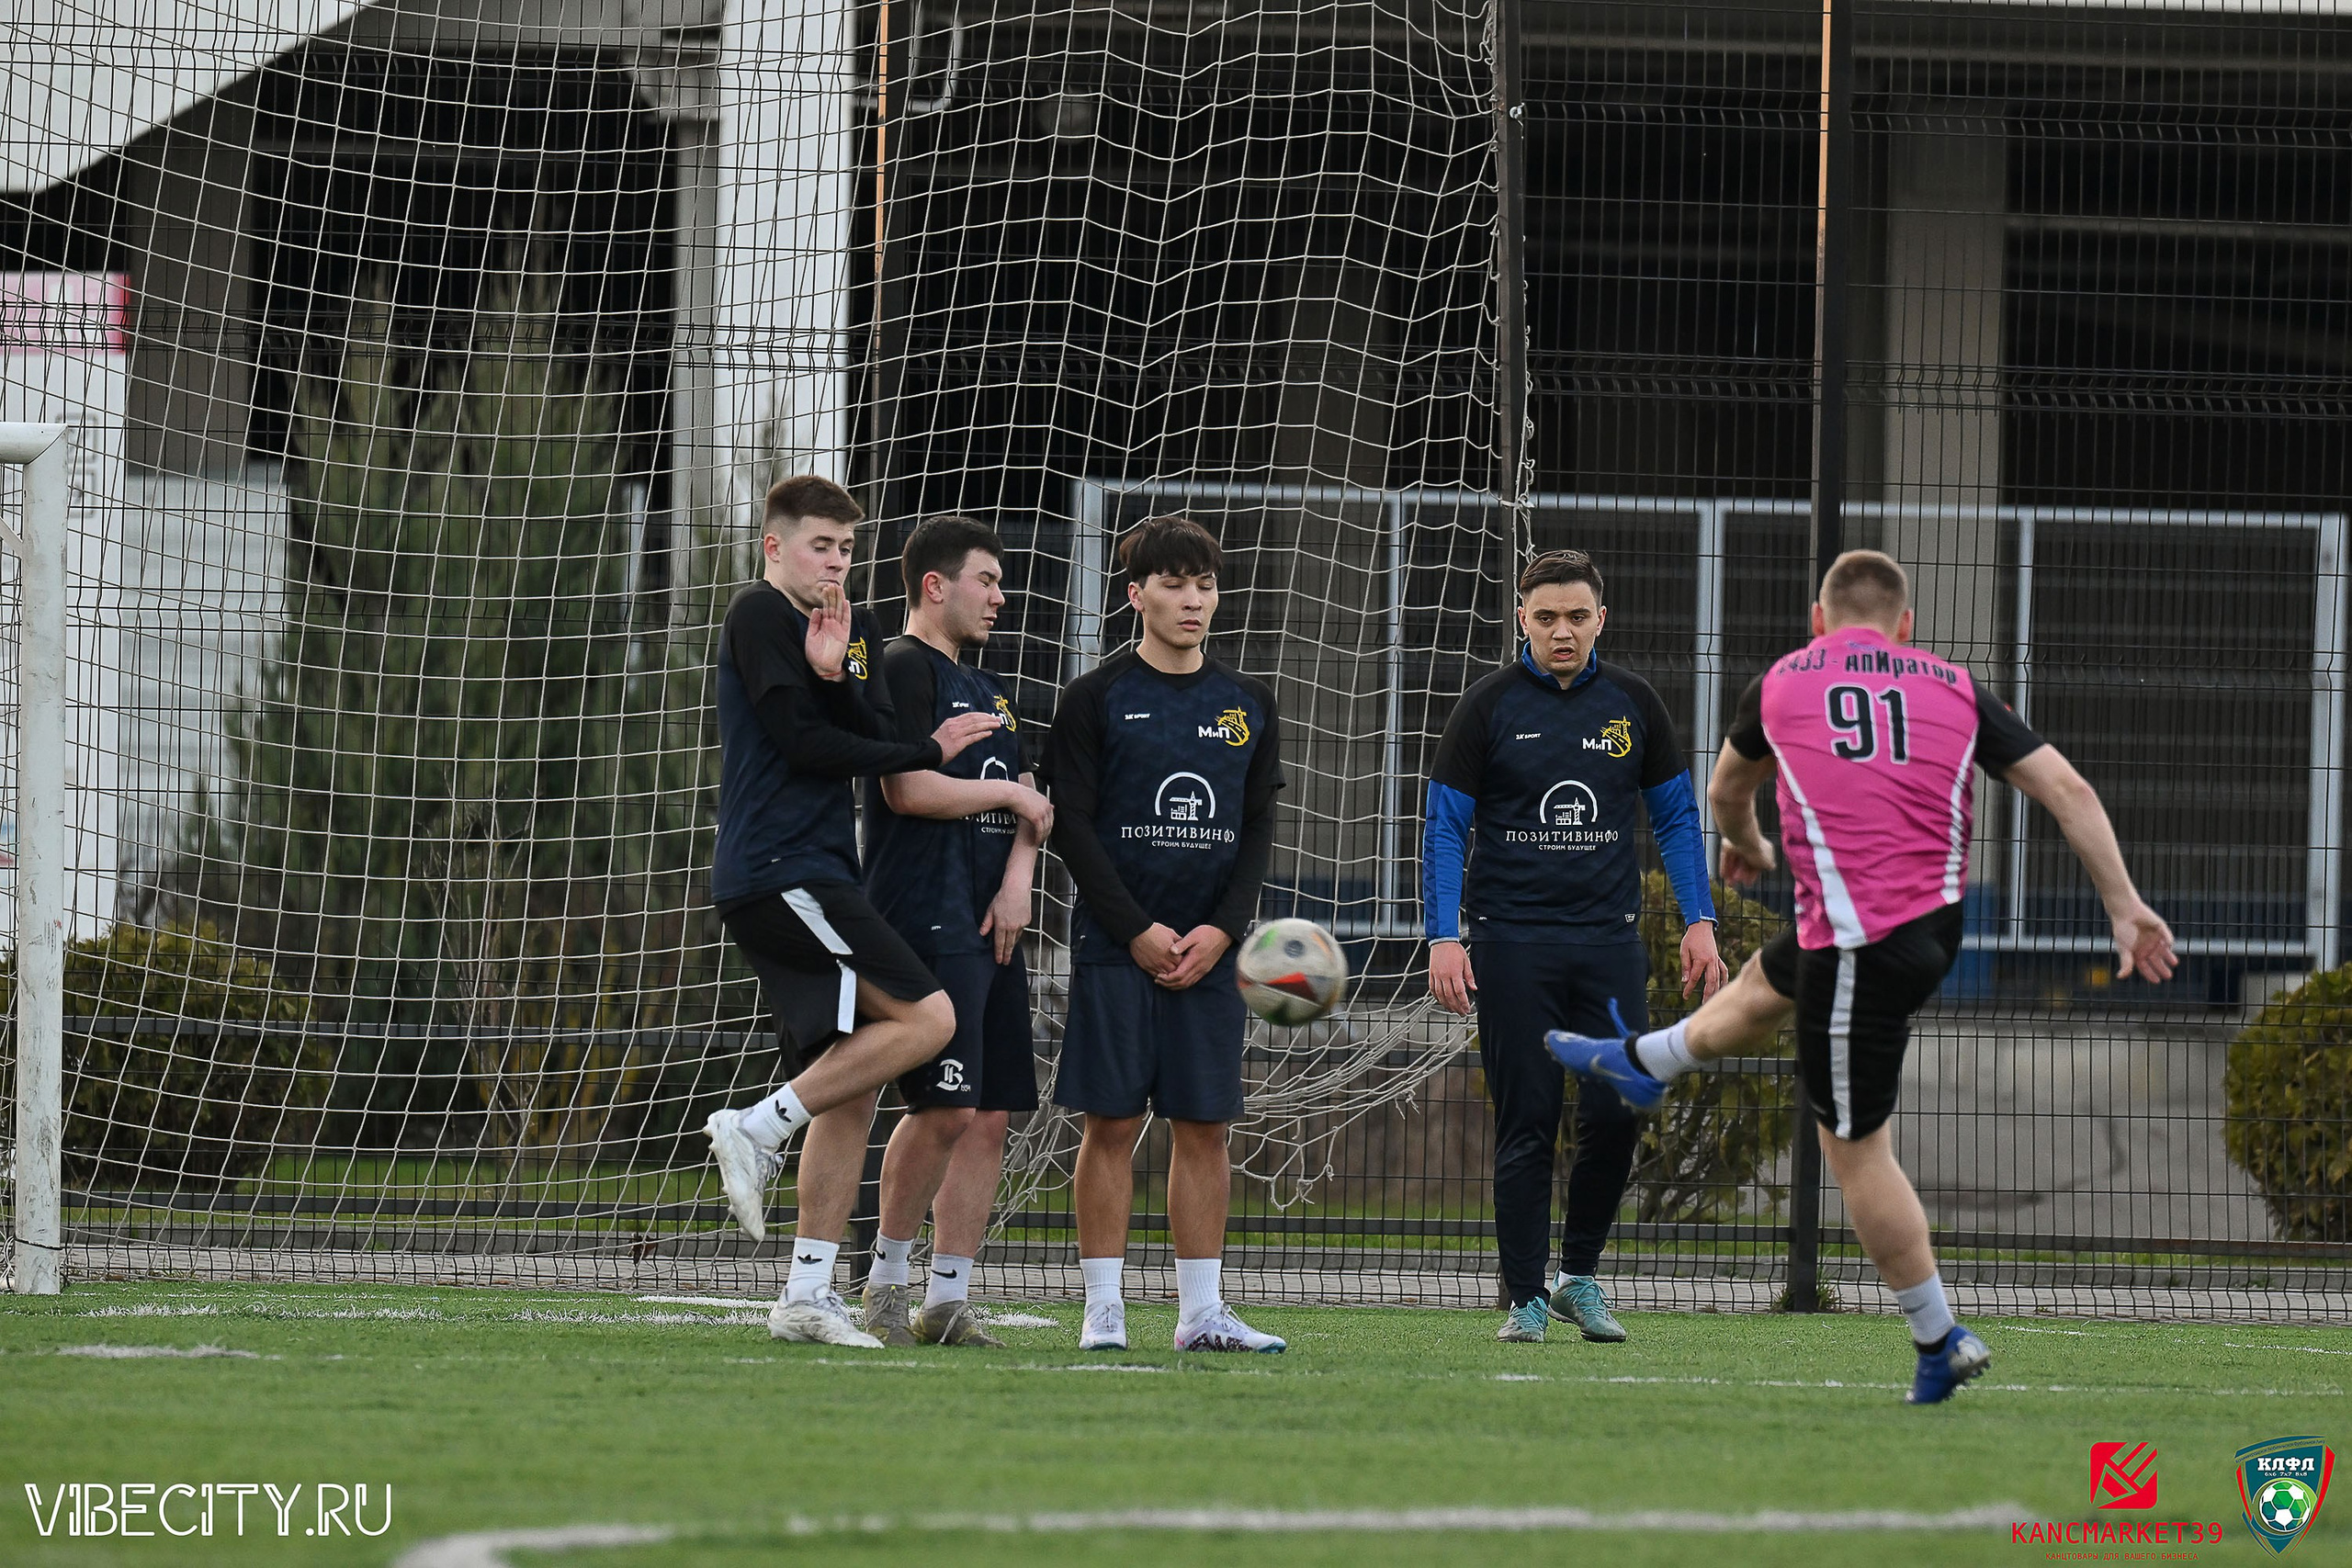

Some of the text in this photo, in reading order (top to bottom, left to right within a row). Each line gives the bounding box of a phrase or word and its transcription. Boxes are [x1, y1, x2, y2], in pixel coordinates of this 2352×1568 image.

[1825, 682, 1909, 765] 91
[1198, 726, 1230, 739] МиП
[1582, 738, 1612, 750] МиП
[1505, 829, 1620, 843] ПОЗИТИВИНФО
